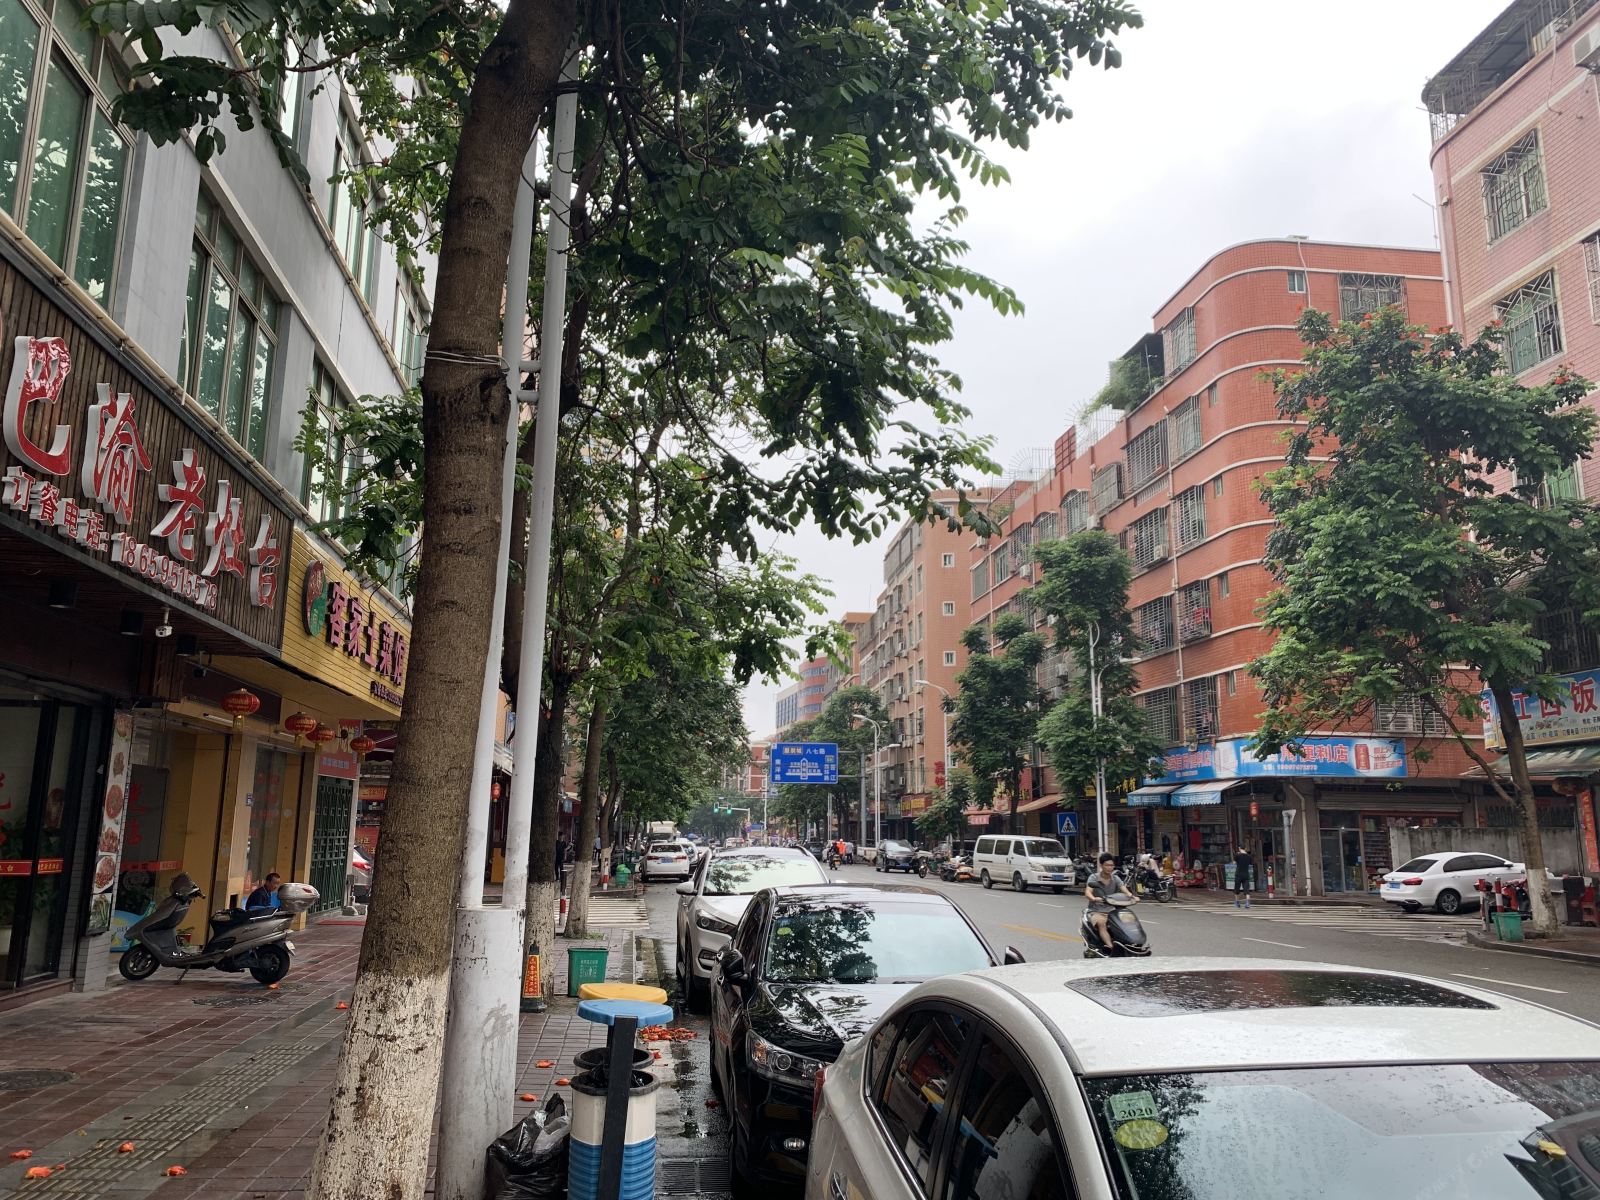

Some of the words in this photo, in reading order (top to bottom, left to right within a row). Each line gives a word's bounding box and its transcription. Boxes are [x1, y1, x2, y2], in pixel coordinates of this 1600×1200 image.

[325, 581, 405, 687] 客家土菜馆
[1119, 1107, 1153, 1119] 2020
